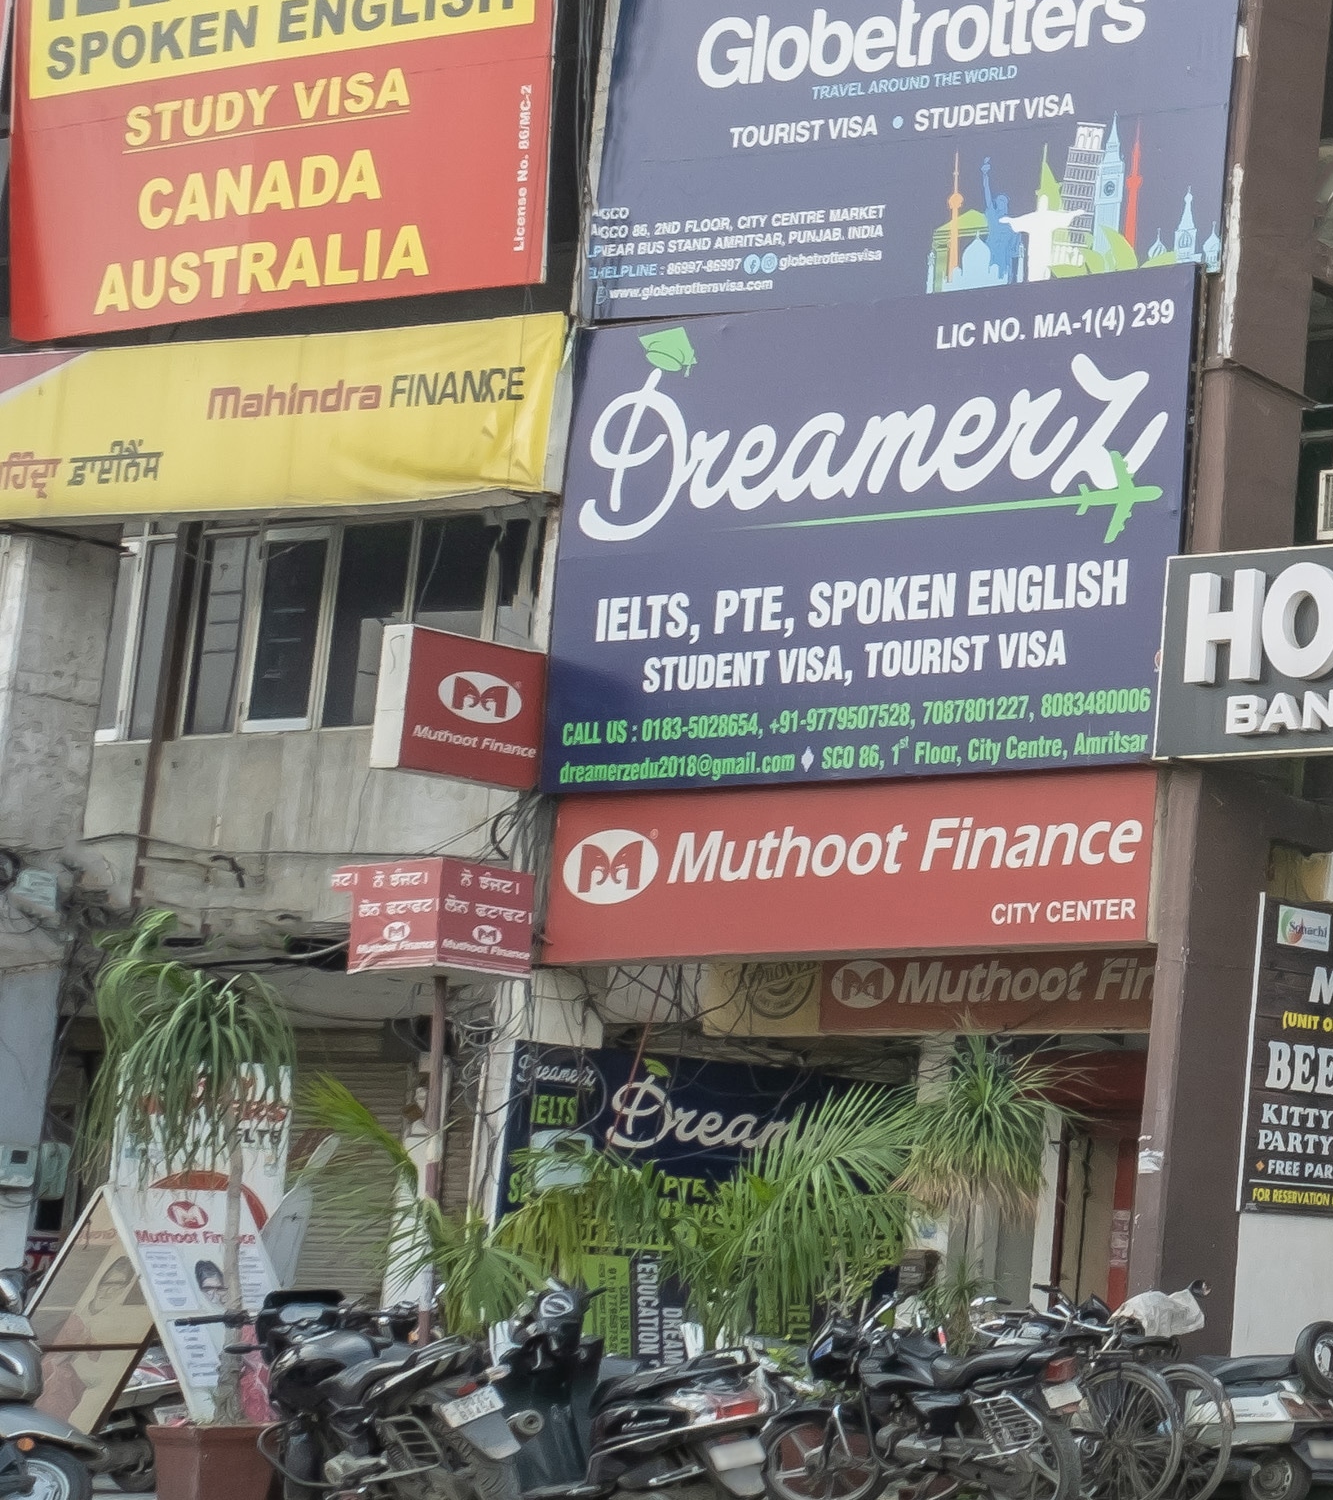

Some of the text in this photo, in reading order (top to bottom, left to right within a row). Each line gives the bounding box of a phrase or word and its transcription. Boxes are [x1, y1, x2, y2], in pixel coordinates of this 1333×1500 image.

[46, 6, 258, 81] SPOKEN
[125, 68, 410, 147] STUDY VISA
[812, 65, 1017, 100] TRAVEL AROUND THE WORLD
[730, 94, 1074, 148] TOURIST VISA STUDENT VISA
[139, 149, 381, 230] CANADA
[513, 154, 529, 252] License No.
[637, 240, 665, 255] BUS
[667, 237, 711, 253] STAND
[848, 224, 884, 240] INDIA
[654, 221, 681, 236] 2ND
[737, 214, 768, 230] CITY
[771, 210, 825, 227] CENTRE
[829, 205, 886, 222] MARKET
[94, 225, 429, 315] AUSTRALIA
[936, 300, 1173, 350] LIC NO. MA-1(4) 239
[207, 366, 526, 420] Mahindra FINANCE
[596, 558, 1128, 643] IELTS, PTE, SPOKEN ENGLISH
[642, 629, 1066, 693] STUDENT VISA, TOURIST VISA
[412, 724, 536, 758] Muthoot Finance
[562, 720, 601, 746] CALL
[606, 719, 627, 743] US
[1041, 687, 1151, 718] 8083480006
[560, 752, 795, 784] dreamerzedu2018@gmail.com
[822, 746, 854, 769] SCO
[859, 745, 885, 770] 86,
[914, 742, 962, 767] Floor,
[968, 738, 1001, 765] City
[1006, 735, 1068, 760] Centre,
[1073, 731, 1148, 756] Amritsar
[667, 816, 1142, 886] Muthoot Finance
[991, 897, 1135, 926] CITY CENTER
[898, 960, 1087, 1003] Muthoot
[1267, 1159, 1300, 1177] FREE
[1252, 1187, 1329, 1206] FOR RESERVATION
[135, 1230, 199, 1246] Muthoot
